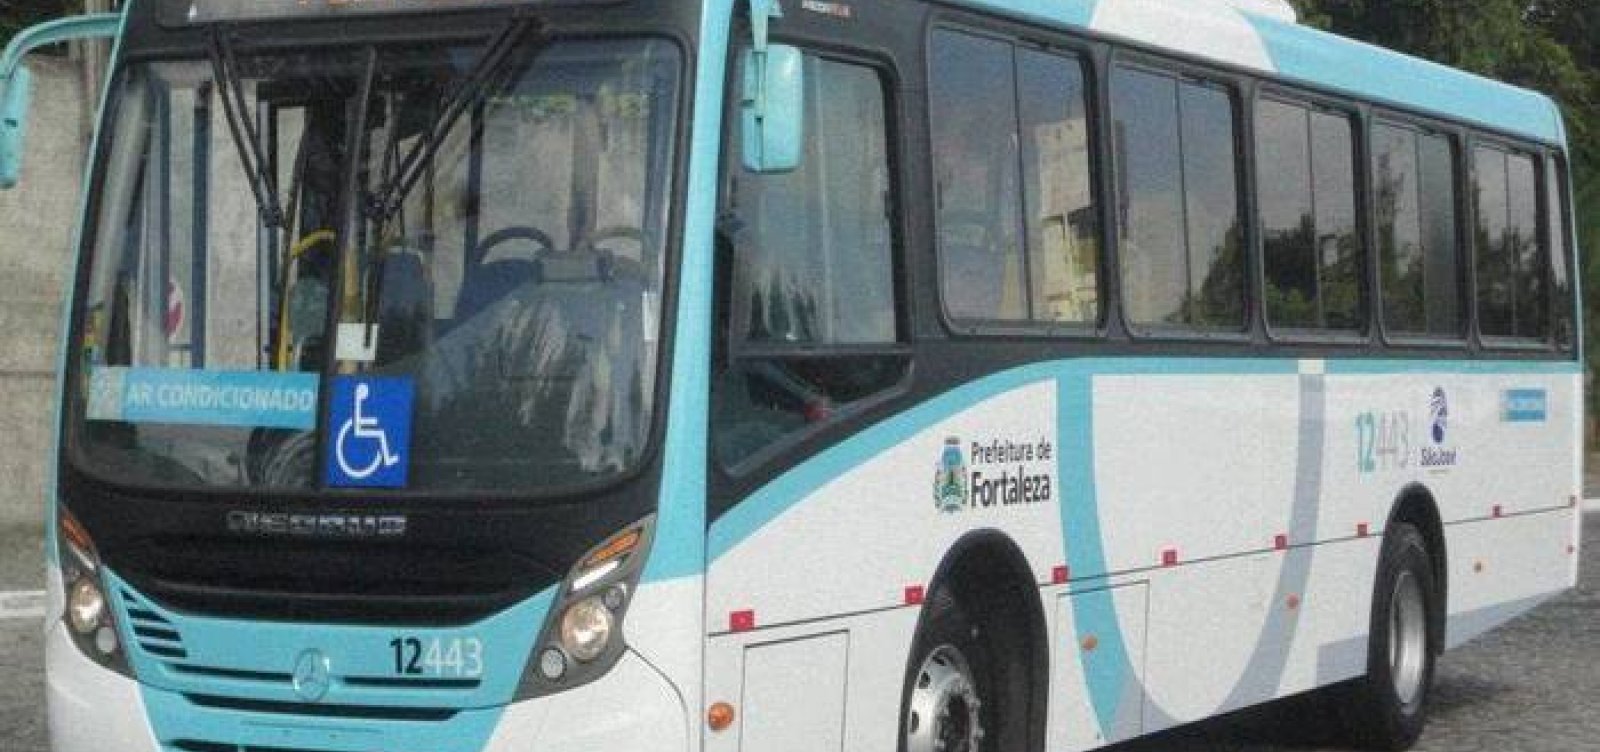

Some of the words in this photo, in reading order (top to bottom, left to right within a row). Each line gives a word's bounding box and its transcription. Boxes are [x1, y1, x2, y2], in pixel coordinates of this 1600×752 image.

[126, 382, 153, 408] AR
[158, 383, 315, 412] CONDICIONADO
[970, 438, 1034, 465] Prefeitura
[1037, 437, 1052, 461] de
[1355, 410, 1408, 473] 12443
[970, 465, 1050, 508] Fortaleza
[389, 636, 483, 676] 12443
